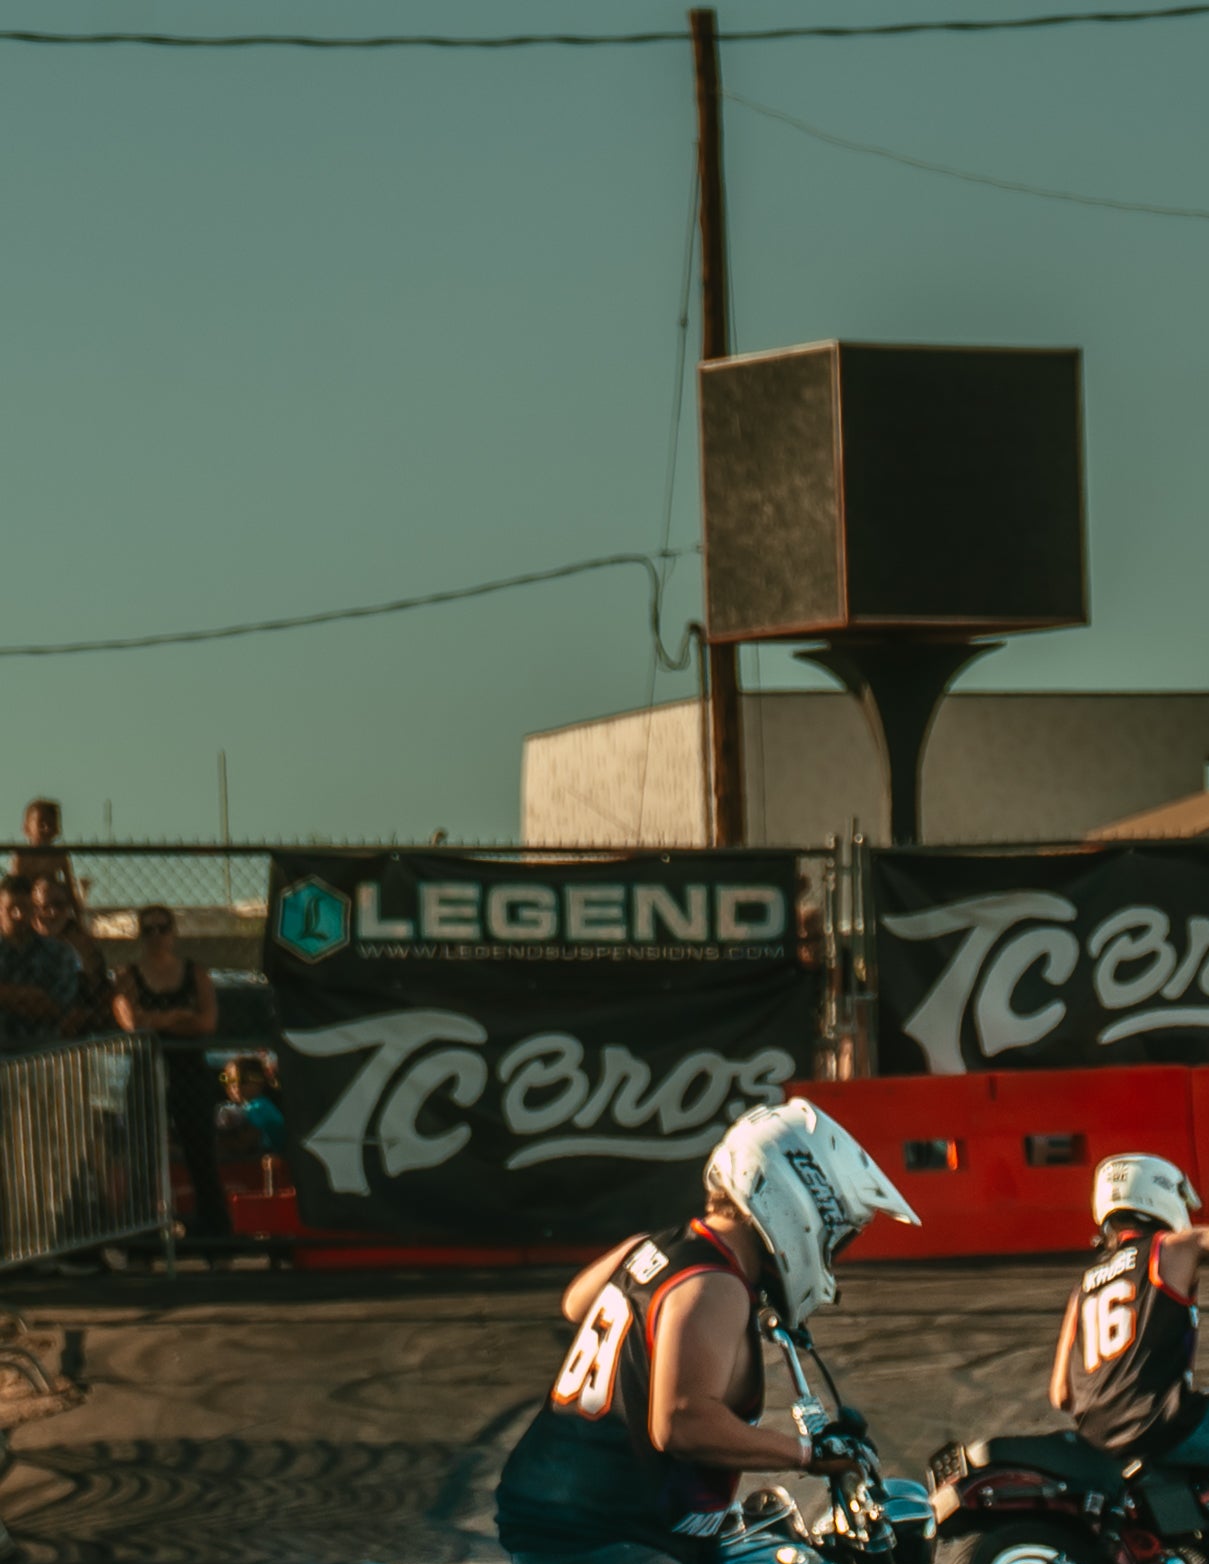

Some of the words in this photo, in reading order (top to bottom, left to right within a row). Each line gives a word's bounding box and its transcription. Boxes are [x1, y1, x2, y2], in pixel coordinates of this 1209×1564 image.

[355, 881, 787, 943] LEGEND
[354, 944, 785, 961] WWW.LEGENDSUSPENSIONS.COM
[1082, 1246, 1138, 1294] KRUSE
[1081, 1279, 1137, 1373] 16
